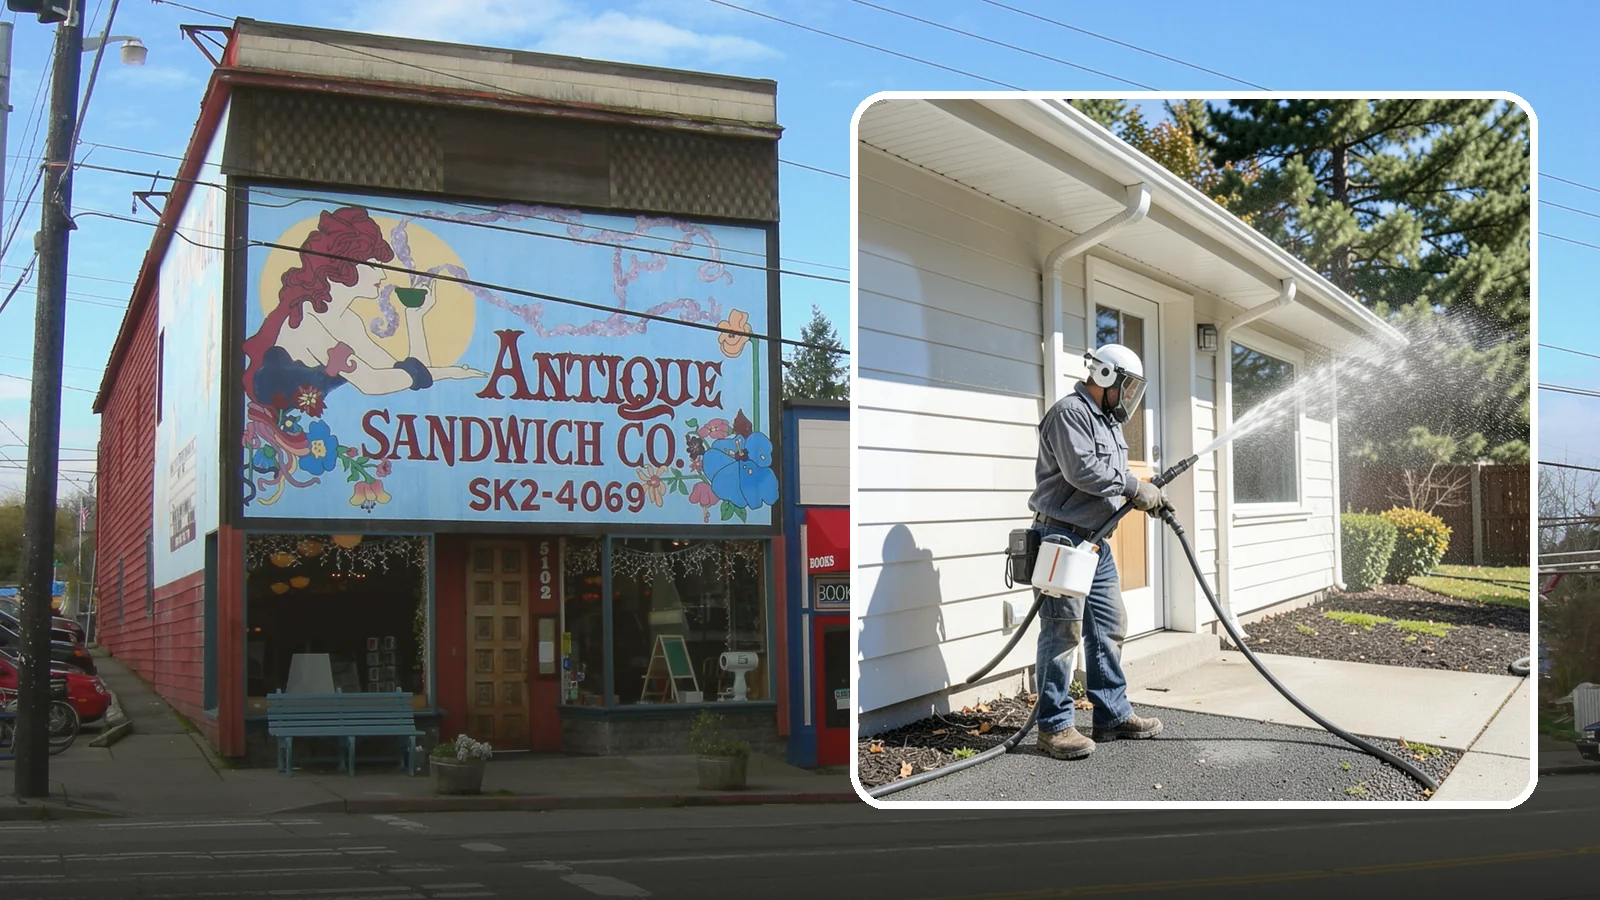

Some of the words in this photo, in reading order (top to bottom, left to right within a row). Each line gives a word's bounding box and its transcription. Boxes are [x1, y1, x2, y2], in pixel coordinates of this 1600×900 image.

[476, 329, 724, 420] ANTIQUE
[361, 408, 605, 467] SANDWICH
[617, 422, 685, 469] CO.
[468, 477, 646, 513] SK2-4069
[540, 541, 552, 600] 5102
[809, 555, 835, 569] BOOKS
